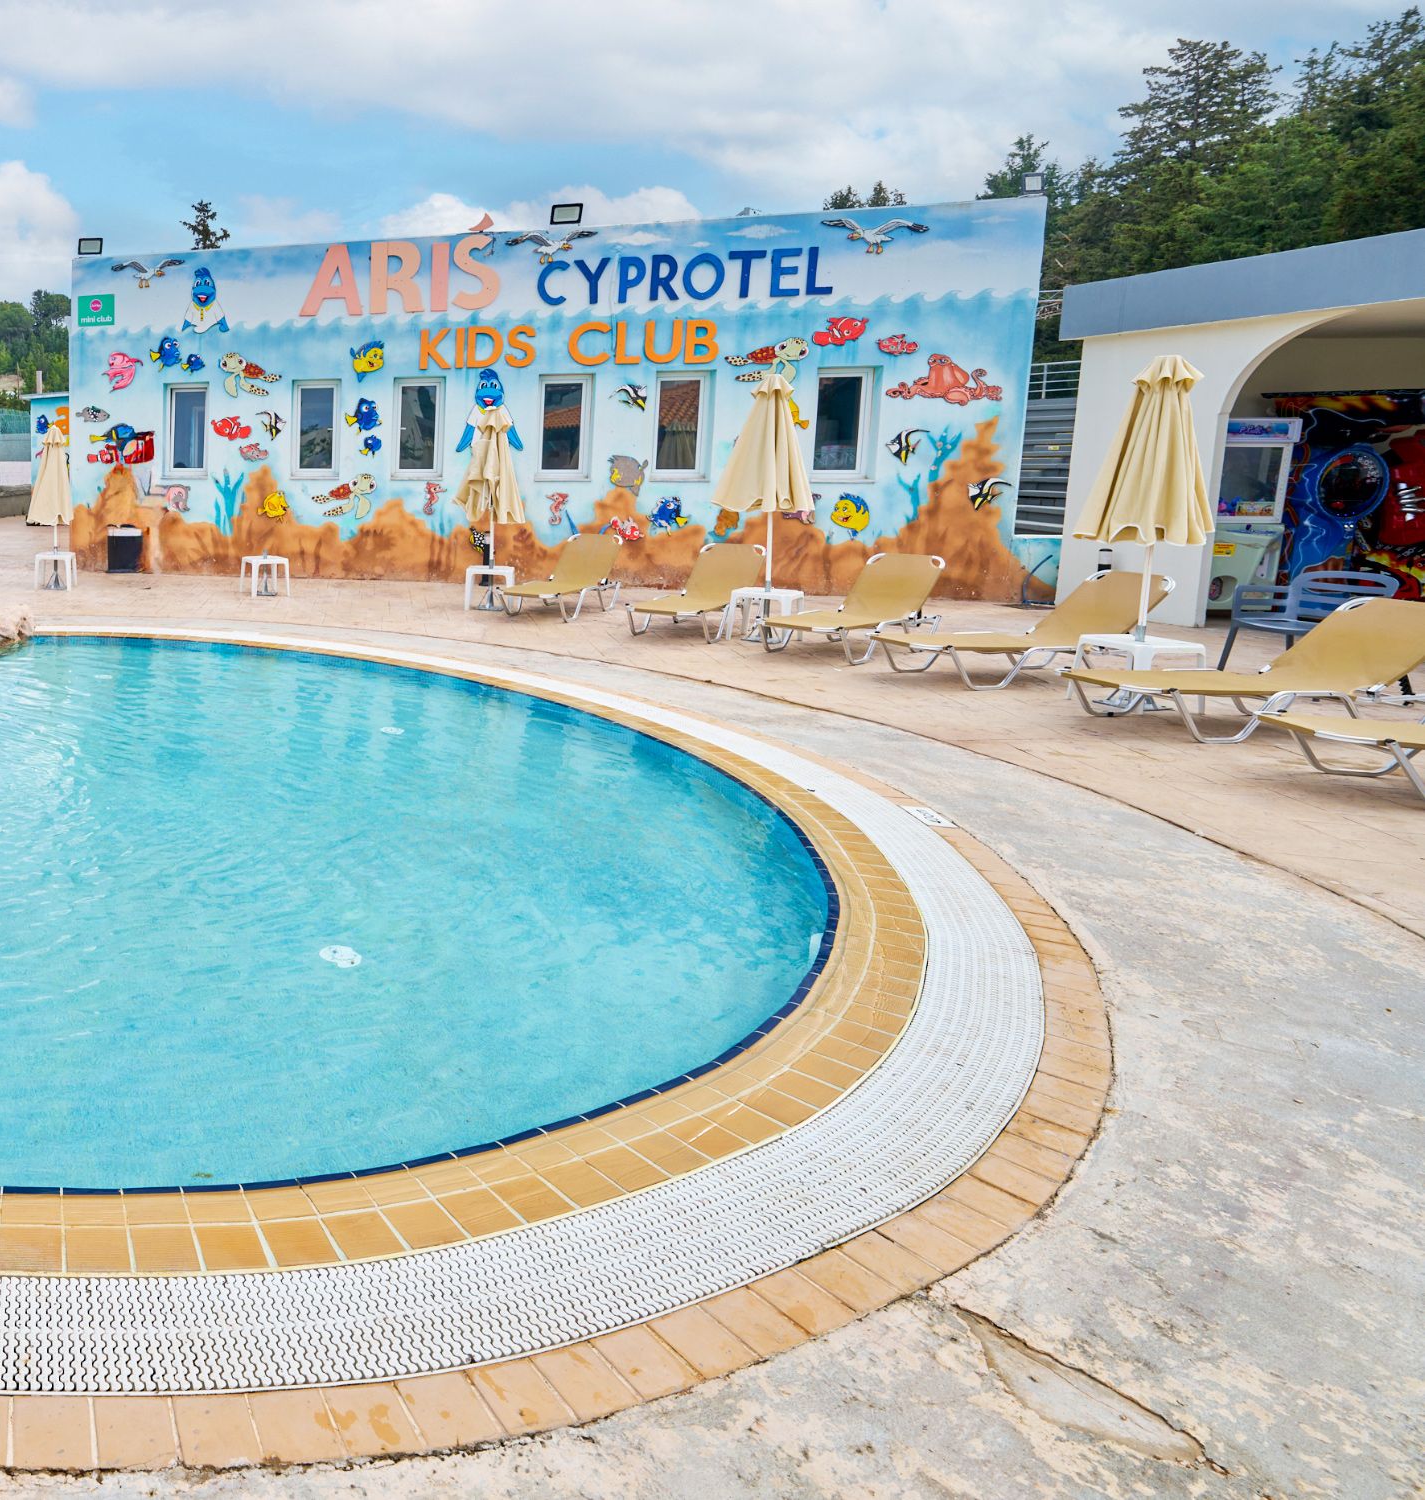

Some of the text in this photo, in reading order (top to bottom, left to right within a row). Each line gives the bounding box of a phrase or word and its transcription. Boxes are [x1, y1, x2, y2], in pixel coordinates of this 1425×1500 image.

[536, 246, 834, 306] CYPROTEL
[80, 315, 113, 324] mini club
[418, 319, 720, 370] KIDS CLUB
